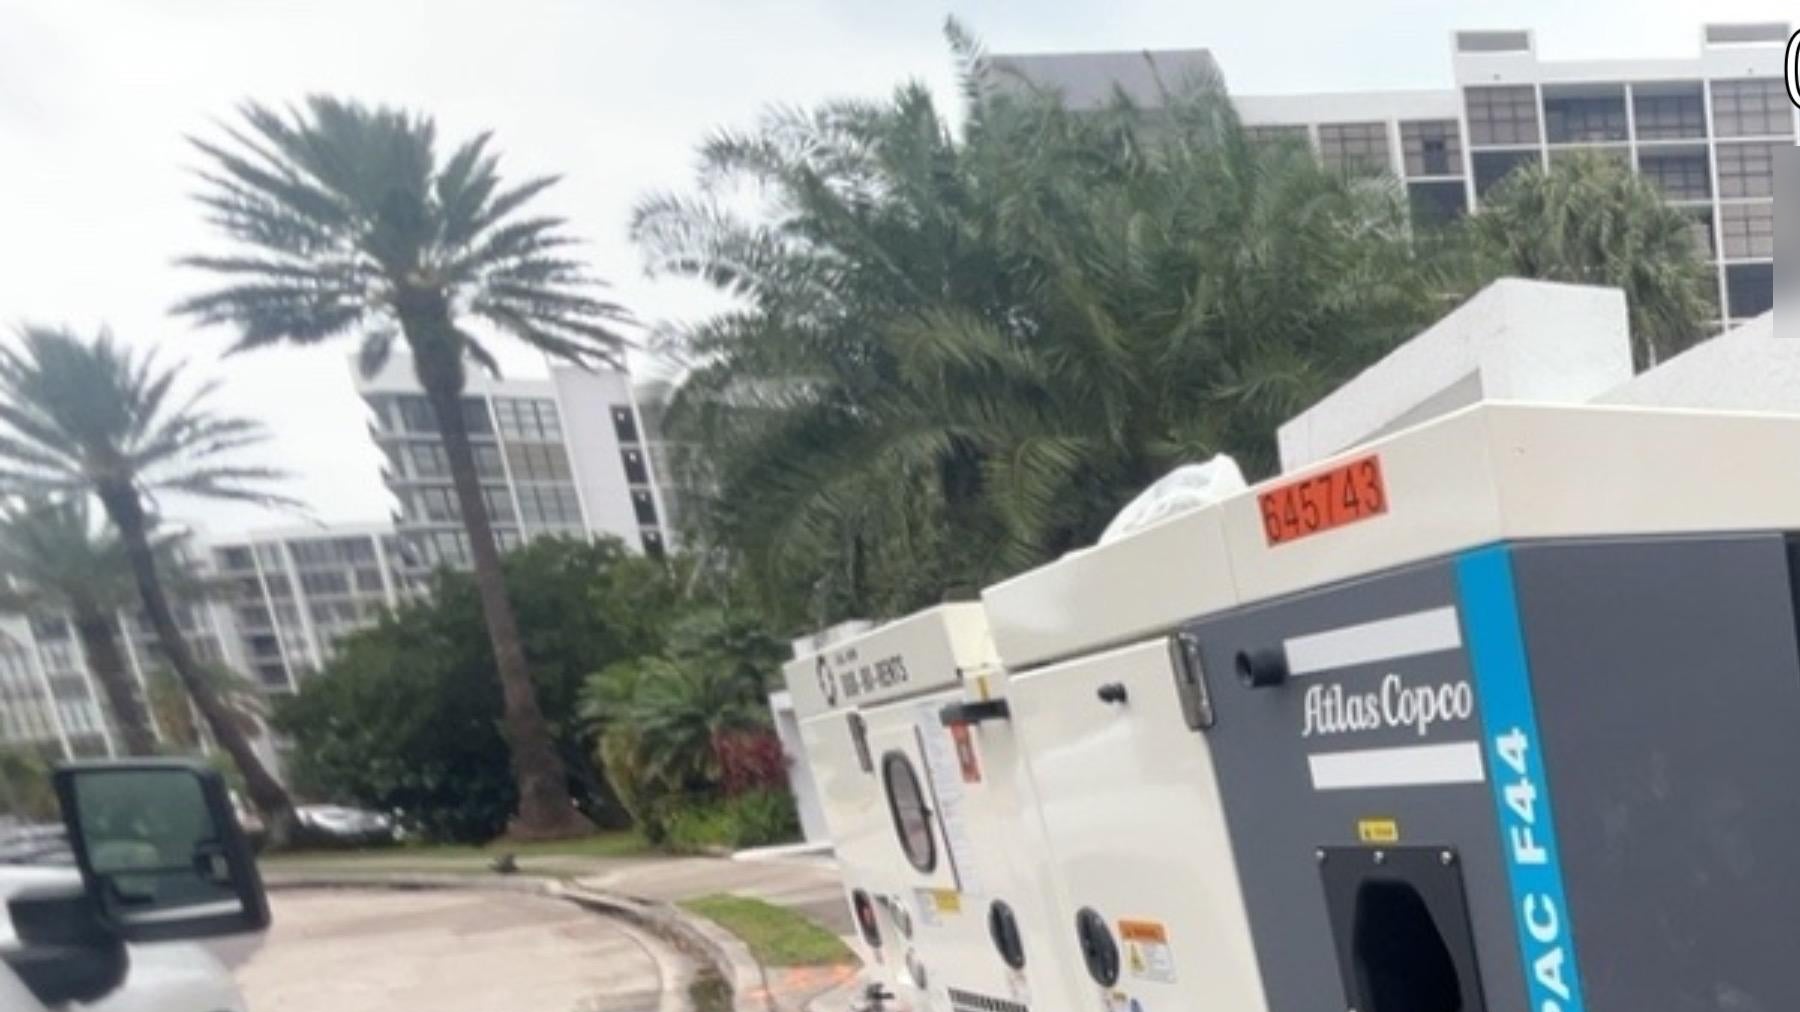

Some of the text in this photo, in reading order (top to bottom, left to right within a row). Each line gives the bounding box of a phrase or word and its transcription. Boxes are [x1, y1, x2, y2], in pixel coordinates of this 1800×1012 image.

[1263, 459, 1386, 542] 645743
[1302, 674, 1474, 736] Atlas Copco
[1495, 727, 1548, 865] F44
